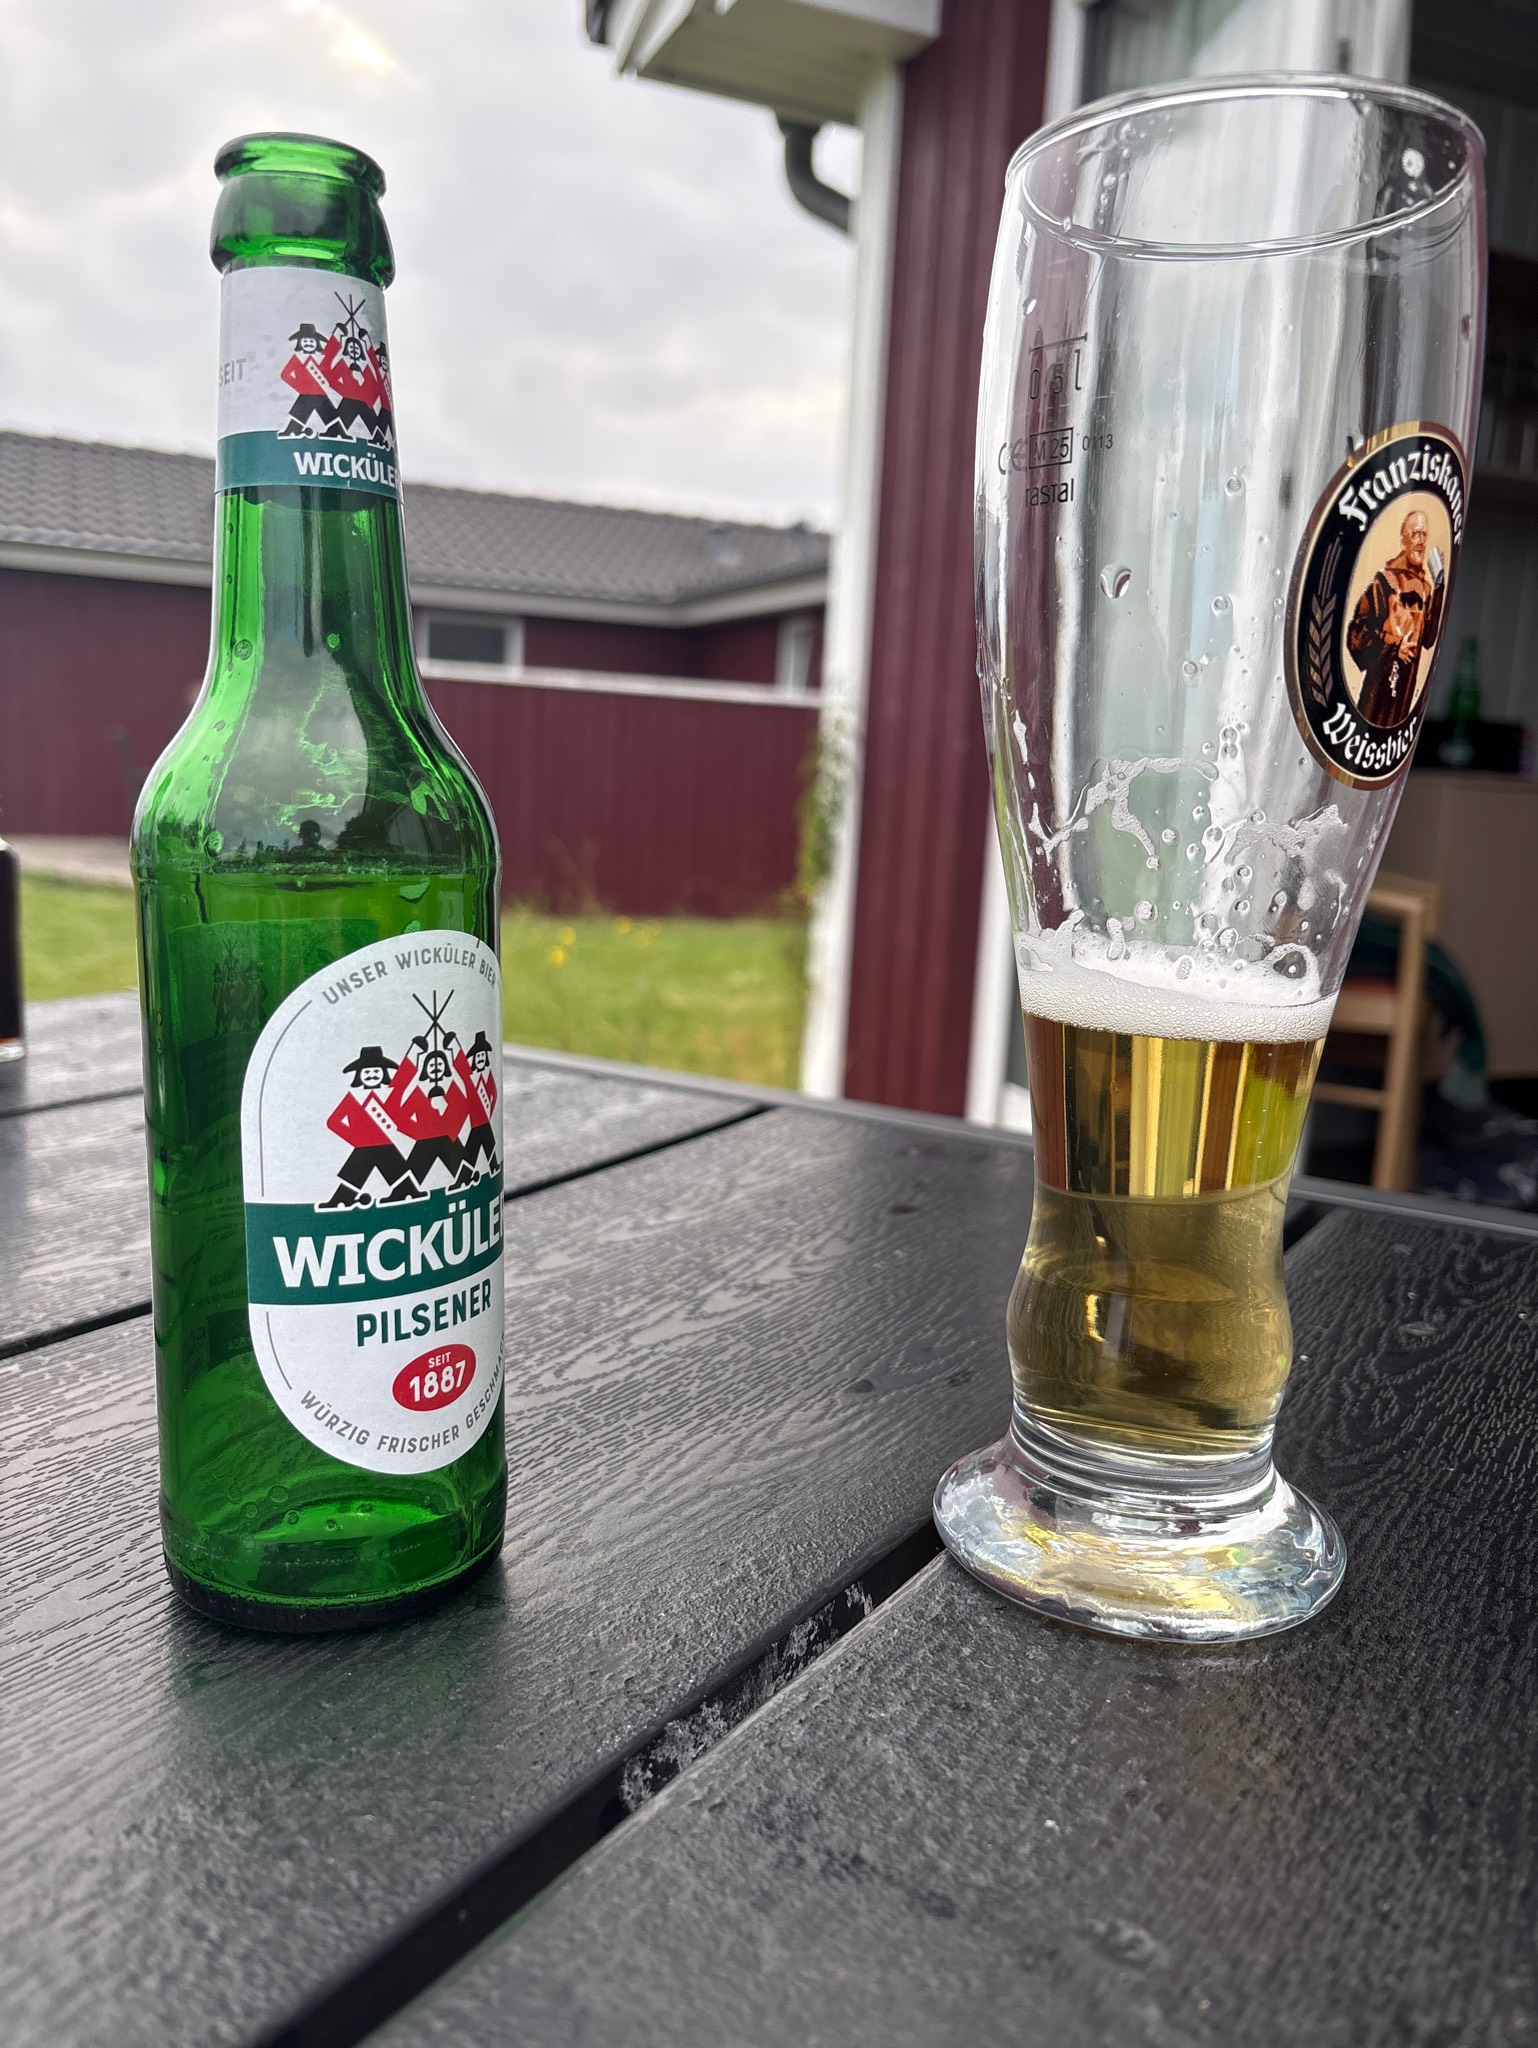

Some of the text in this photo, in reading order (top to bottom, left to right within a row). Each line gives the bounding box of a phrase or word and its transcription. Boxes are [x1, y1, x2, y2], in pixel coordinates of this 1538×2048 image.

[1338, 443, 1463, 546] Franziskaner
[1322, 702, 1418, 771] Weissbier
[322, 943, 496, 1005] UNSER WICKÜLER BIER
[356, 1277, 492, 1348] PILSENER
[408, 1359, 467, 1403] 1887
[427, 1351, 452, 1369] SEIT
[300, 1389, 371, 1446] WÜRZIG
[376, 1423, 460, 1454] FRISCHER
